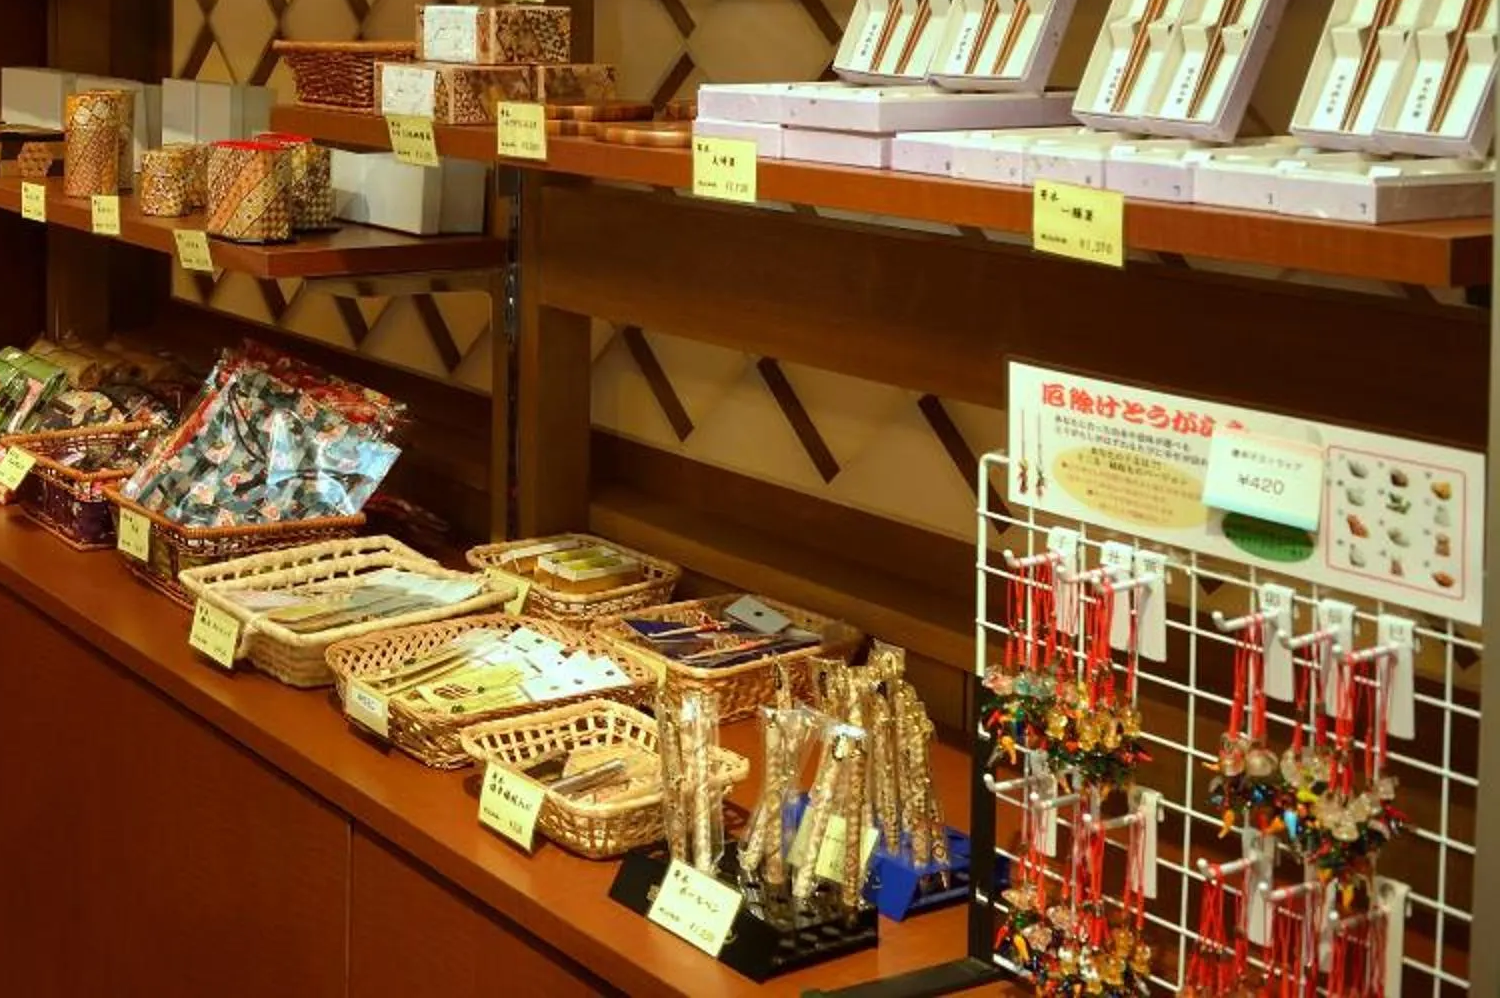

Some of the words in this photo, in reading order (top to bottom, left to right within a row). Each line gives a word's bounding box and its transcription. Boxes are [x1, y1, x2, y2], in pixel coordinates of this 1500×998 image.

[1041, 381, 1245, 438] 厄除けとうがら
